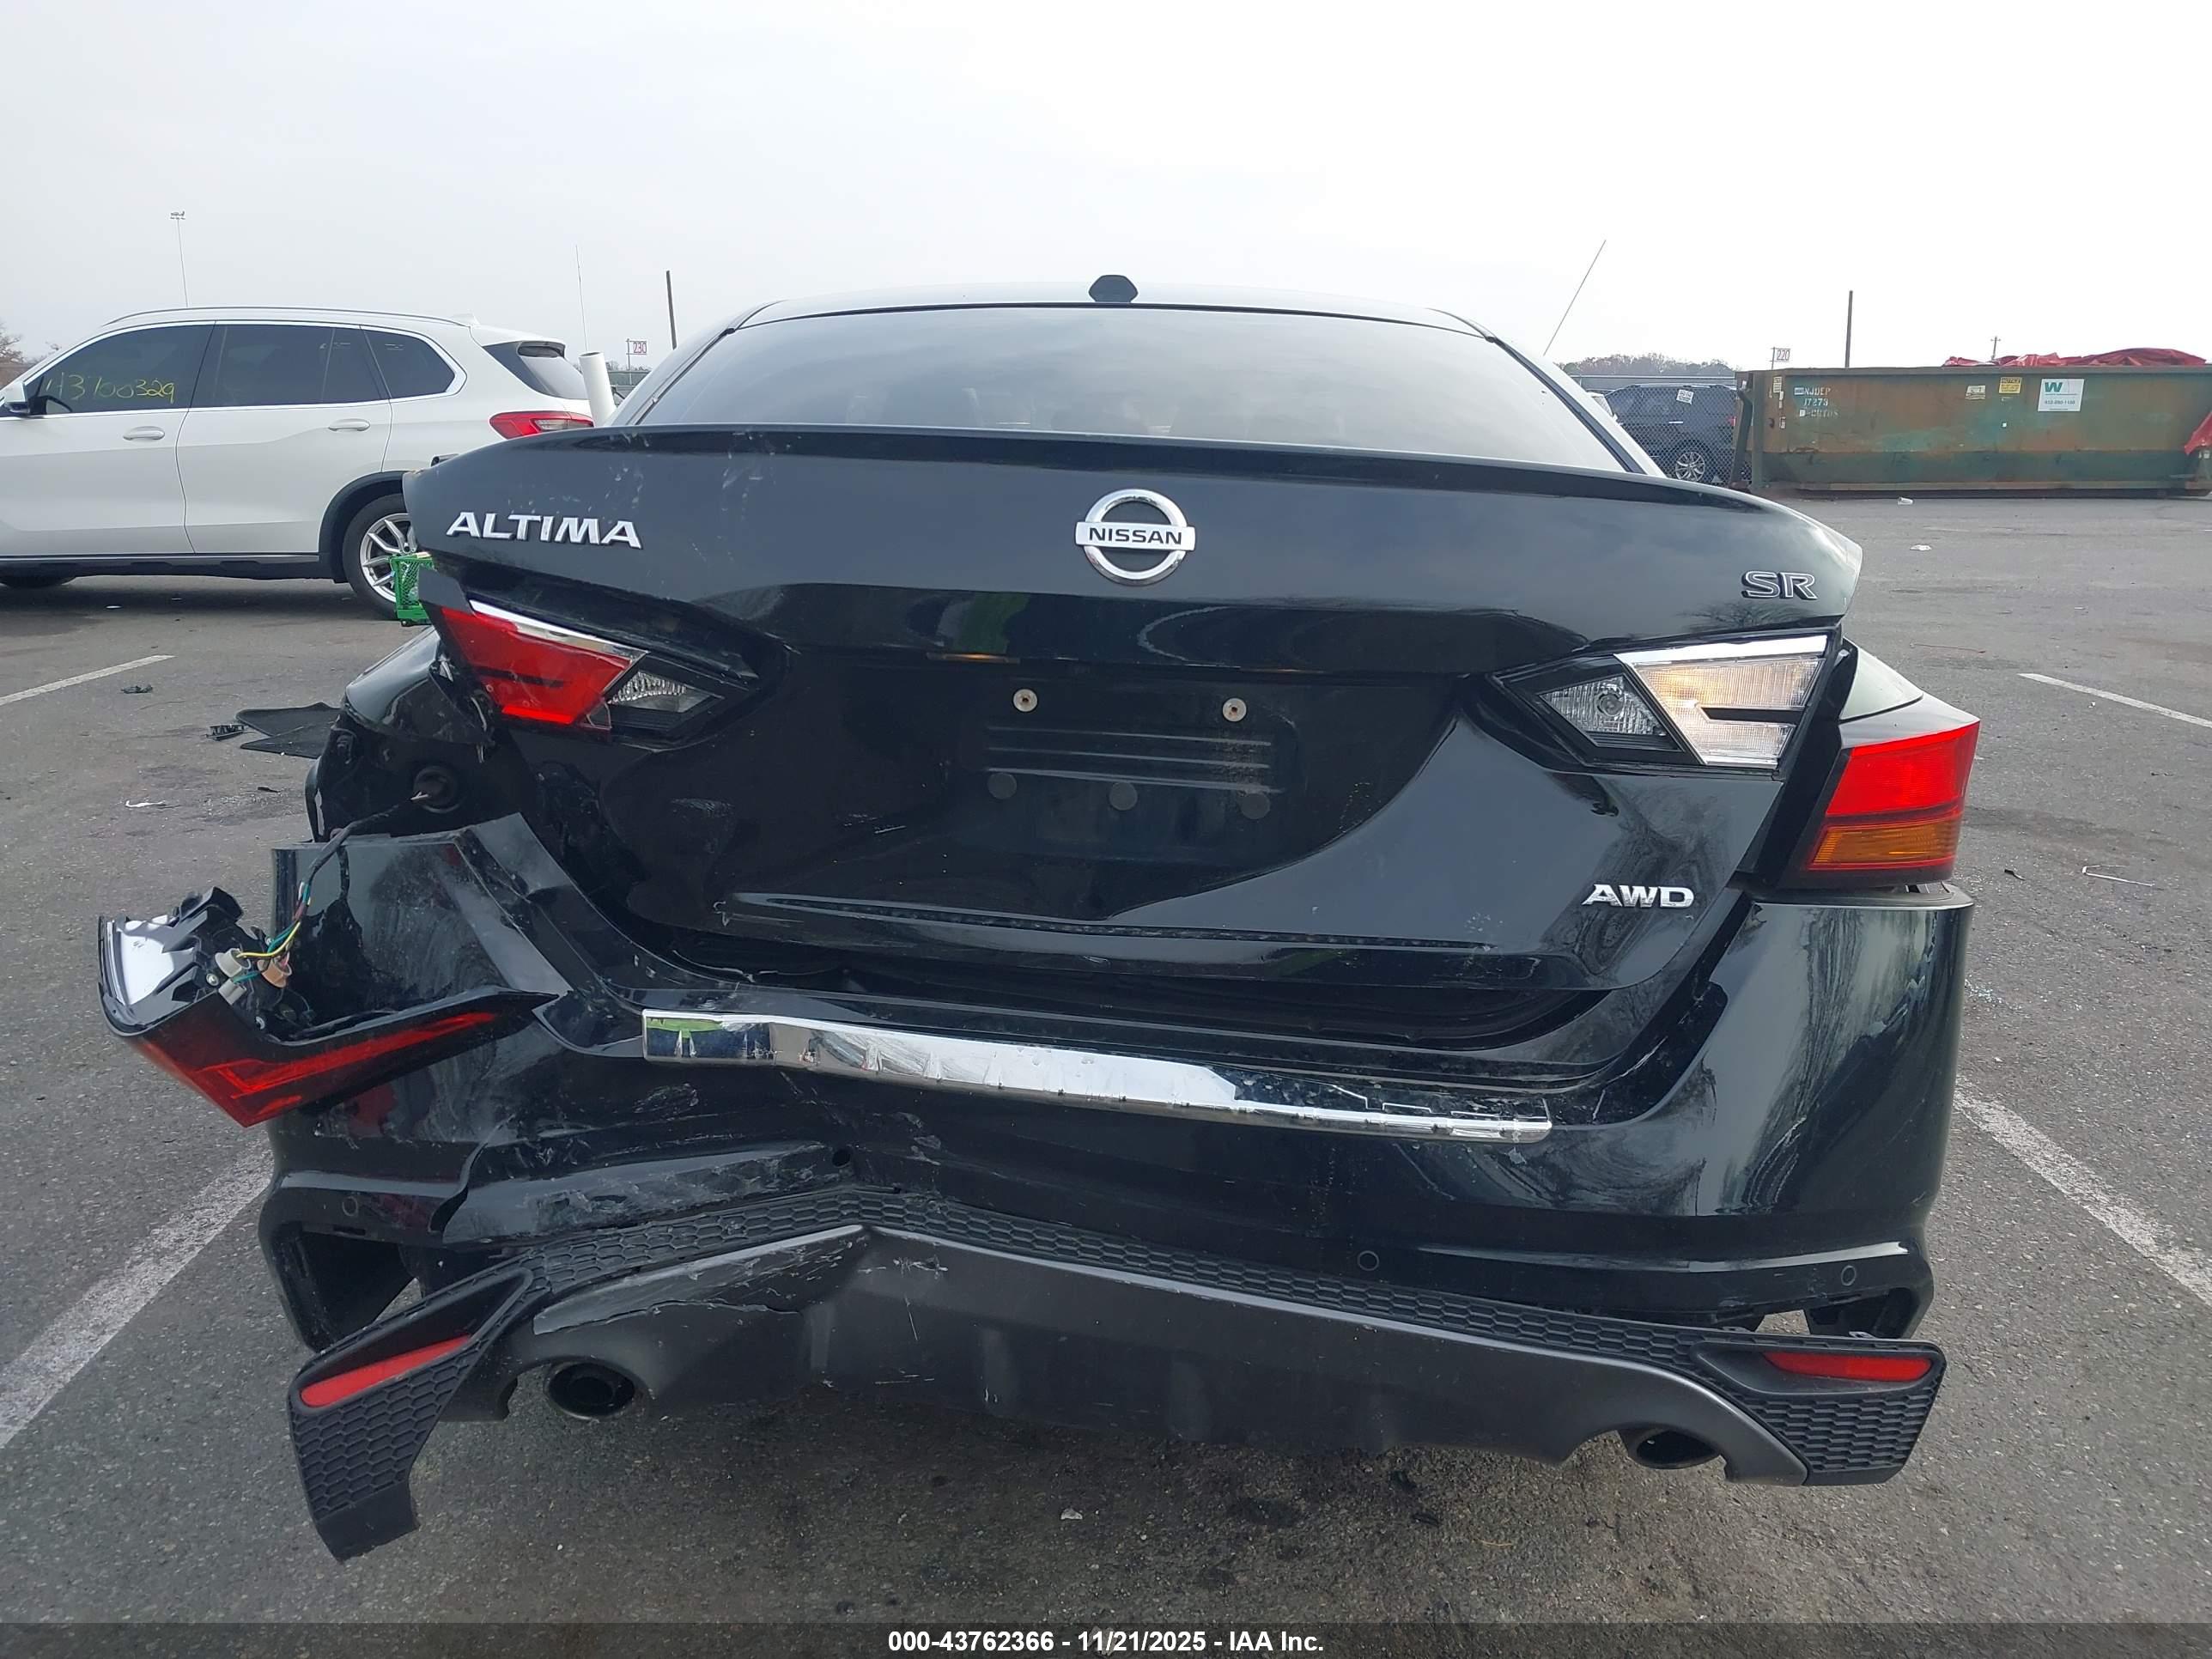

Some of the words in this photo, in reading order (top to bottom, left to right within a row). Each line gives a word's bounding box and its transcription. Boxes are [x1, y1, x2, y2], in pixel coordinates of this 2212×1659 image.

[633, 342, 647, 354] 230
[1777, 349, 1790, 361] 220
[446, 512, 643, 549] ALTIMA
[1089, 527, 1182, 545] NISSAN
[1741, 570, 1818, 600] SR
[1582, 884, 1694, 908] AWD
